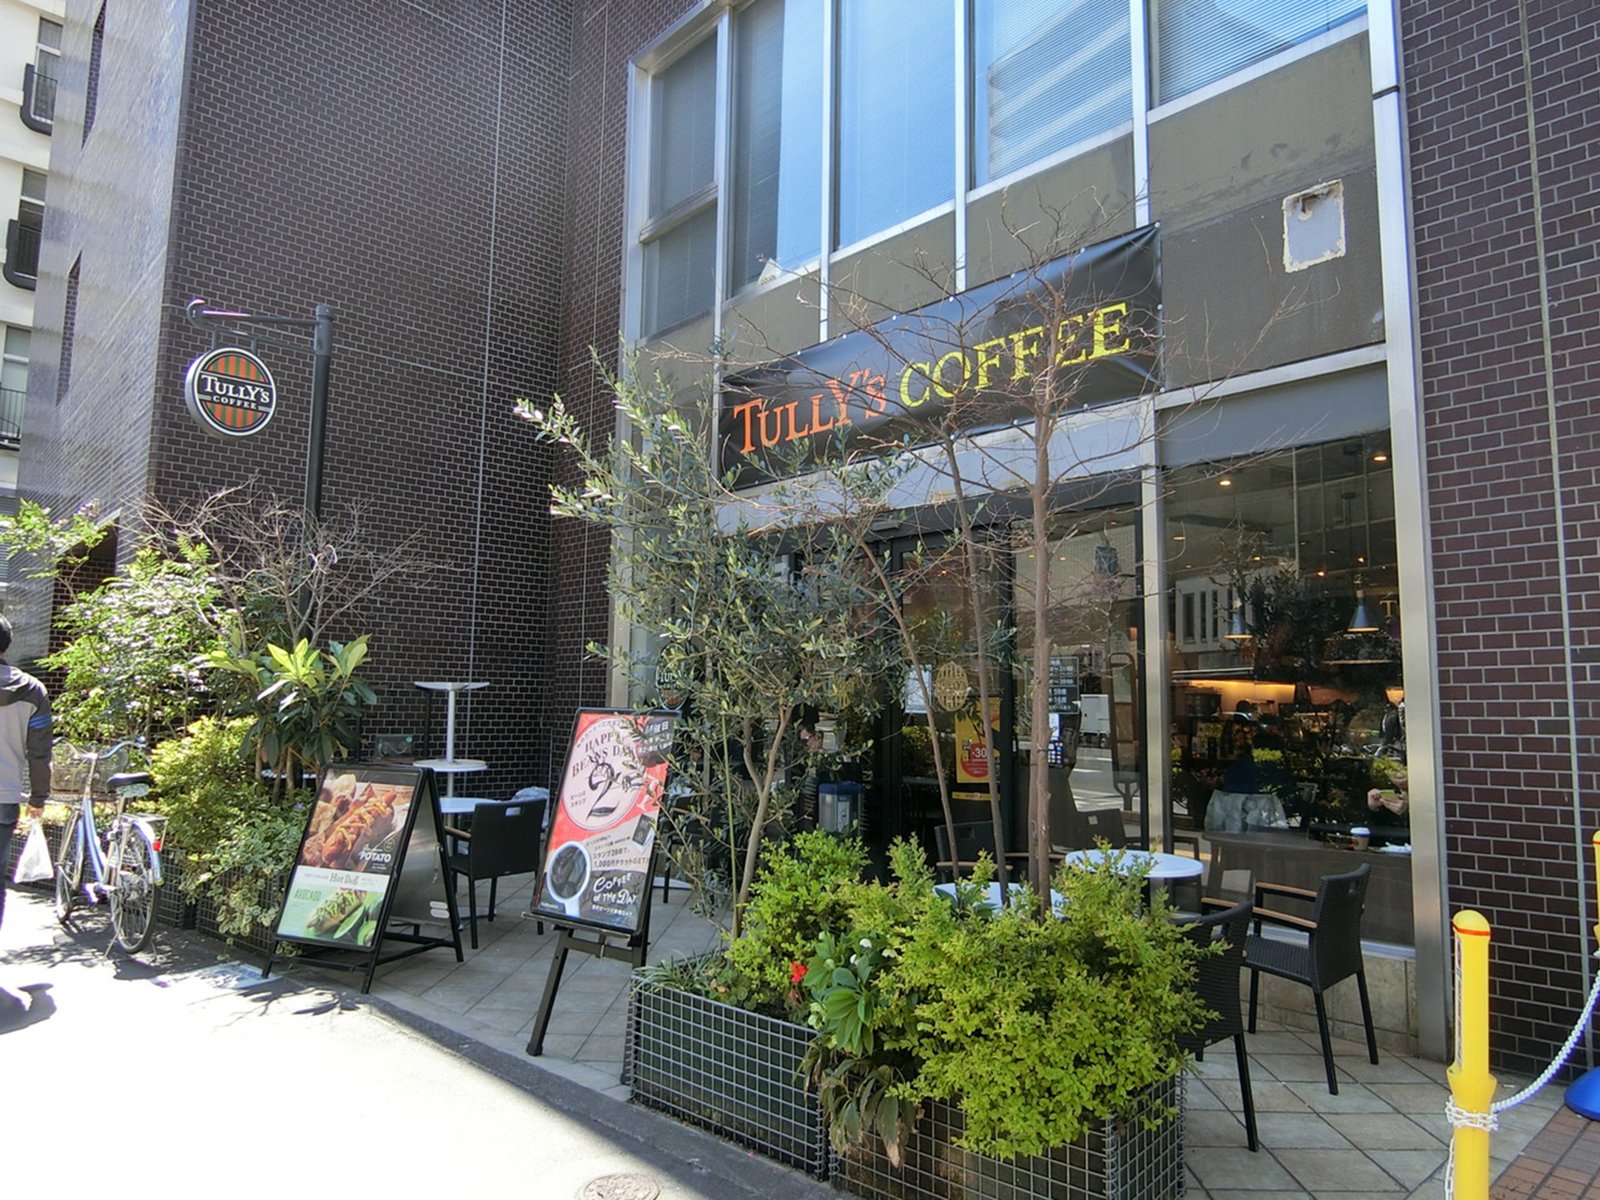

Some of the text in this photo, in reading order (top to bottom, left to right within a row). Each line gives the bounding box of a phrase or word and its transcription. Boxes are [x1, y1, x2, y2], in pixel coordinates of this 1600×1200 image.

[201, 374, 270, 404] TULLY'S
[733, 302, 1131, 454] TULLY'S COFFEE
[213, 395, 258, 410] COFFEE
[571, 746, 609, 778] BEANS
[358, 851, 392, 863] POTATO
